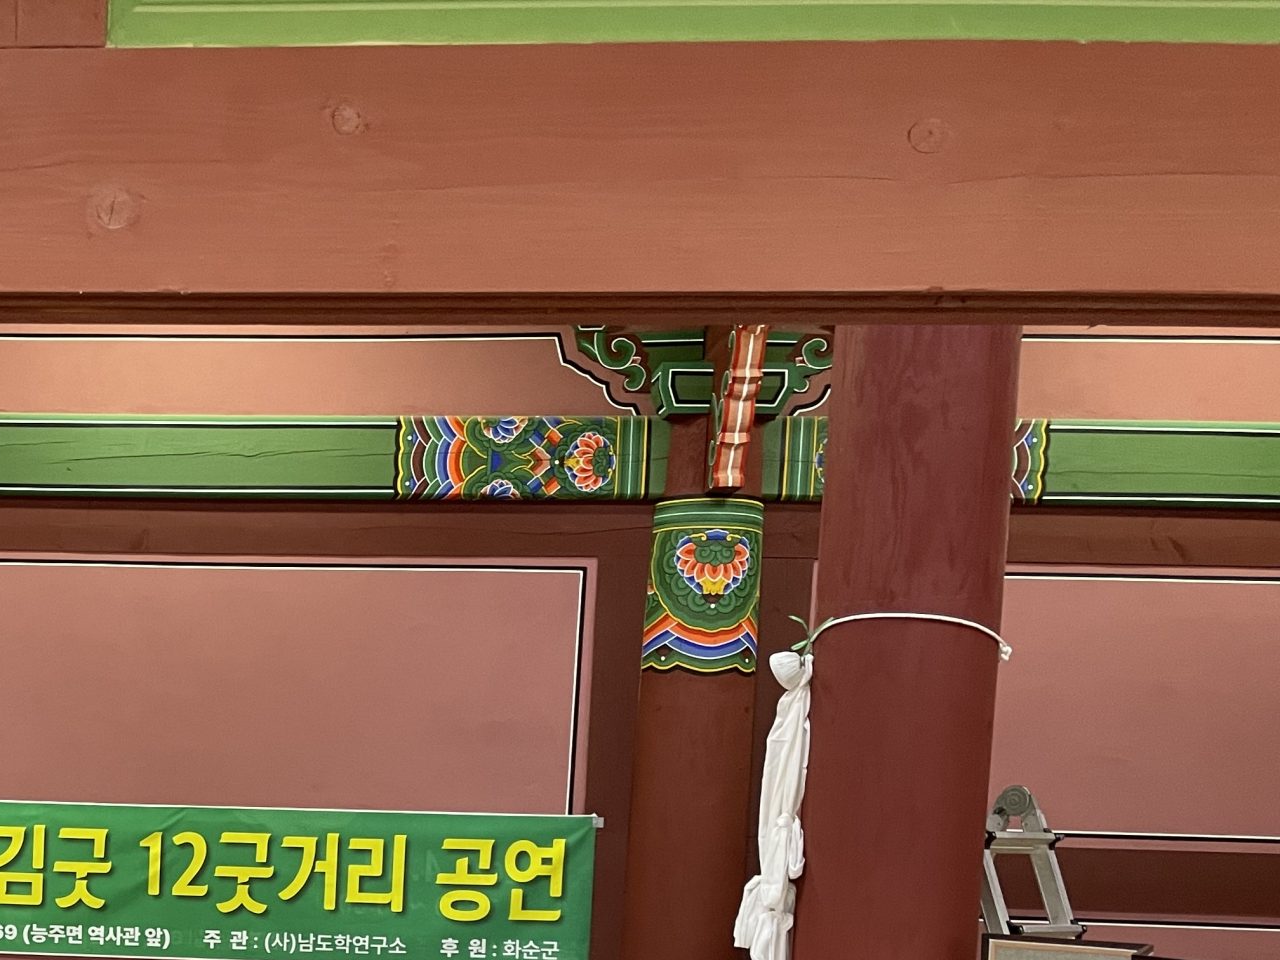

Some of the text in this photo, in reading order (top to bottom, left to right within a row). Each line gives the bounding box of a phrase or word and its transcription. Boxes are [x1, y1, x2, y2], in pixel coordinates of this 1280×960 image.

[139, 831, 407, 914] 12굿거리
[435, 838, 567, 922] 공연
[22, 923, 83, 945] (능주면
[87, 926, 141, 947] 역사관
[144, 927, 170, 949] 앞)
[264, 931, 408, 956] (사)남도학연구소
[502, 939, 560, 960] 화순군
